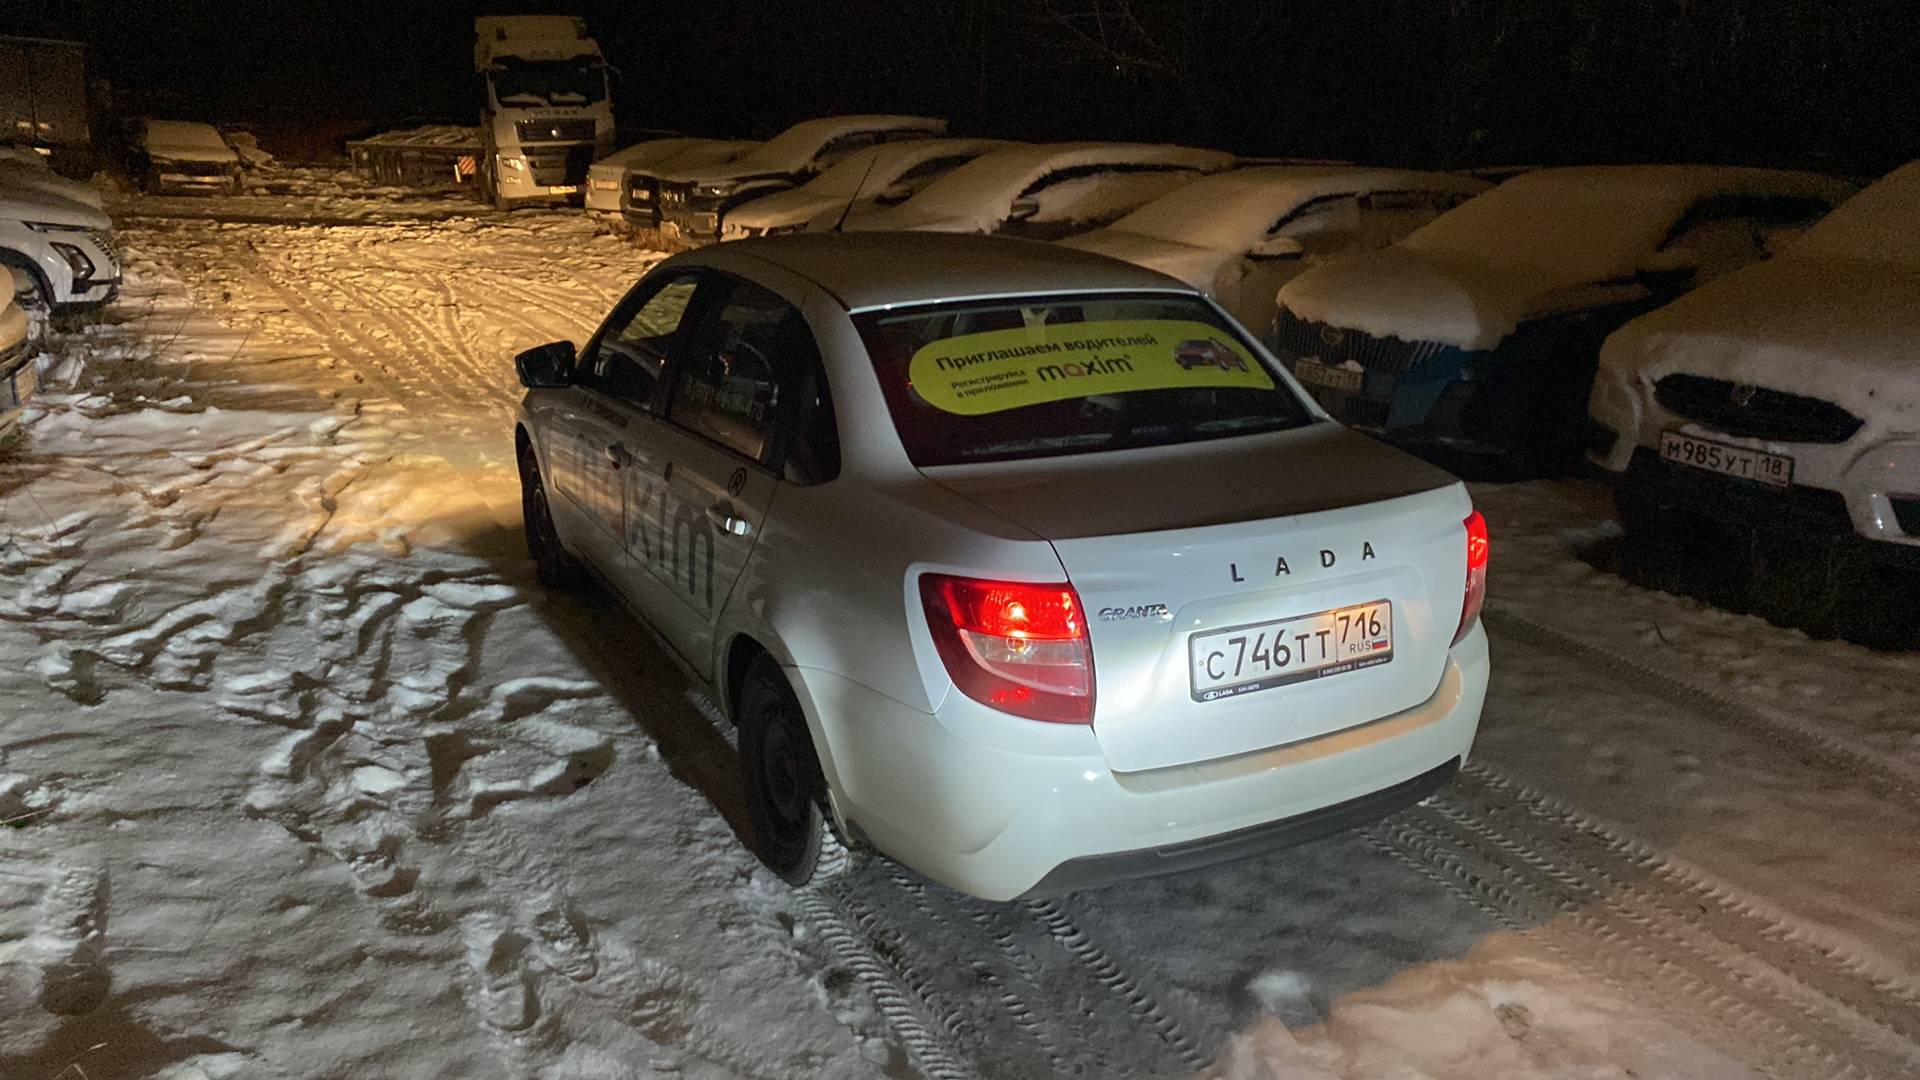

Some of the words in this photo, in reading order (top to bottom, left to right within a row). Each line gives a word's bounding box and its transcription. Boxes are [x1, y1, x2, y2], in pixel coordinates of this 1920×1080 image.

[935, 343, 1060, 371] Приглашаем
[1063, 333, 1158, 352] водителей
[1036, 355, 1134, 382] maxim
[1667, 440, 1753, 474] М985УТ
[1761, 456, 1783, 476] 18
[1230, 541, 1376, 583] LADA
[1098, 603, 1168, 621] GRANTA
[1206, 630, 1330, 680] С746ТТ
[1337, 610, 1382, 644] 716
[1350, 640, 1372, 654] RUS
[1219, 688, 1233, 697] LADA
